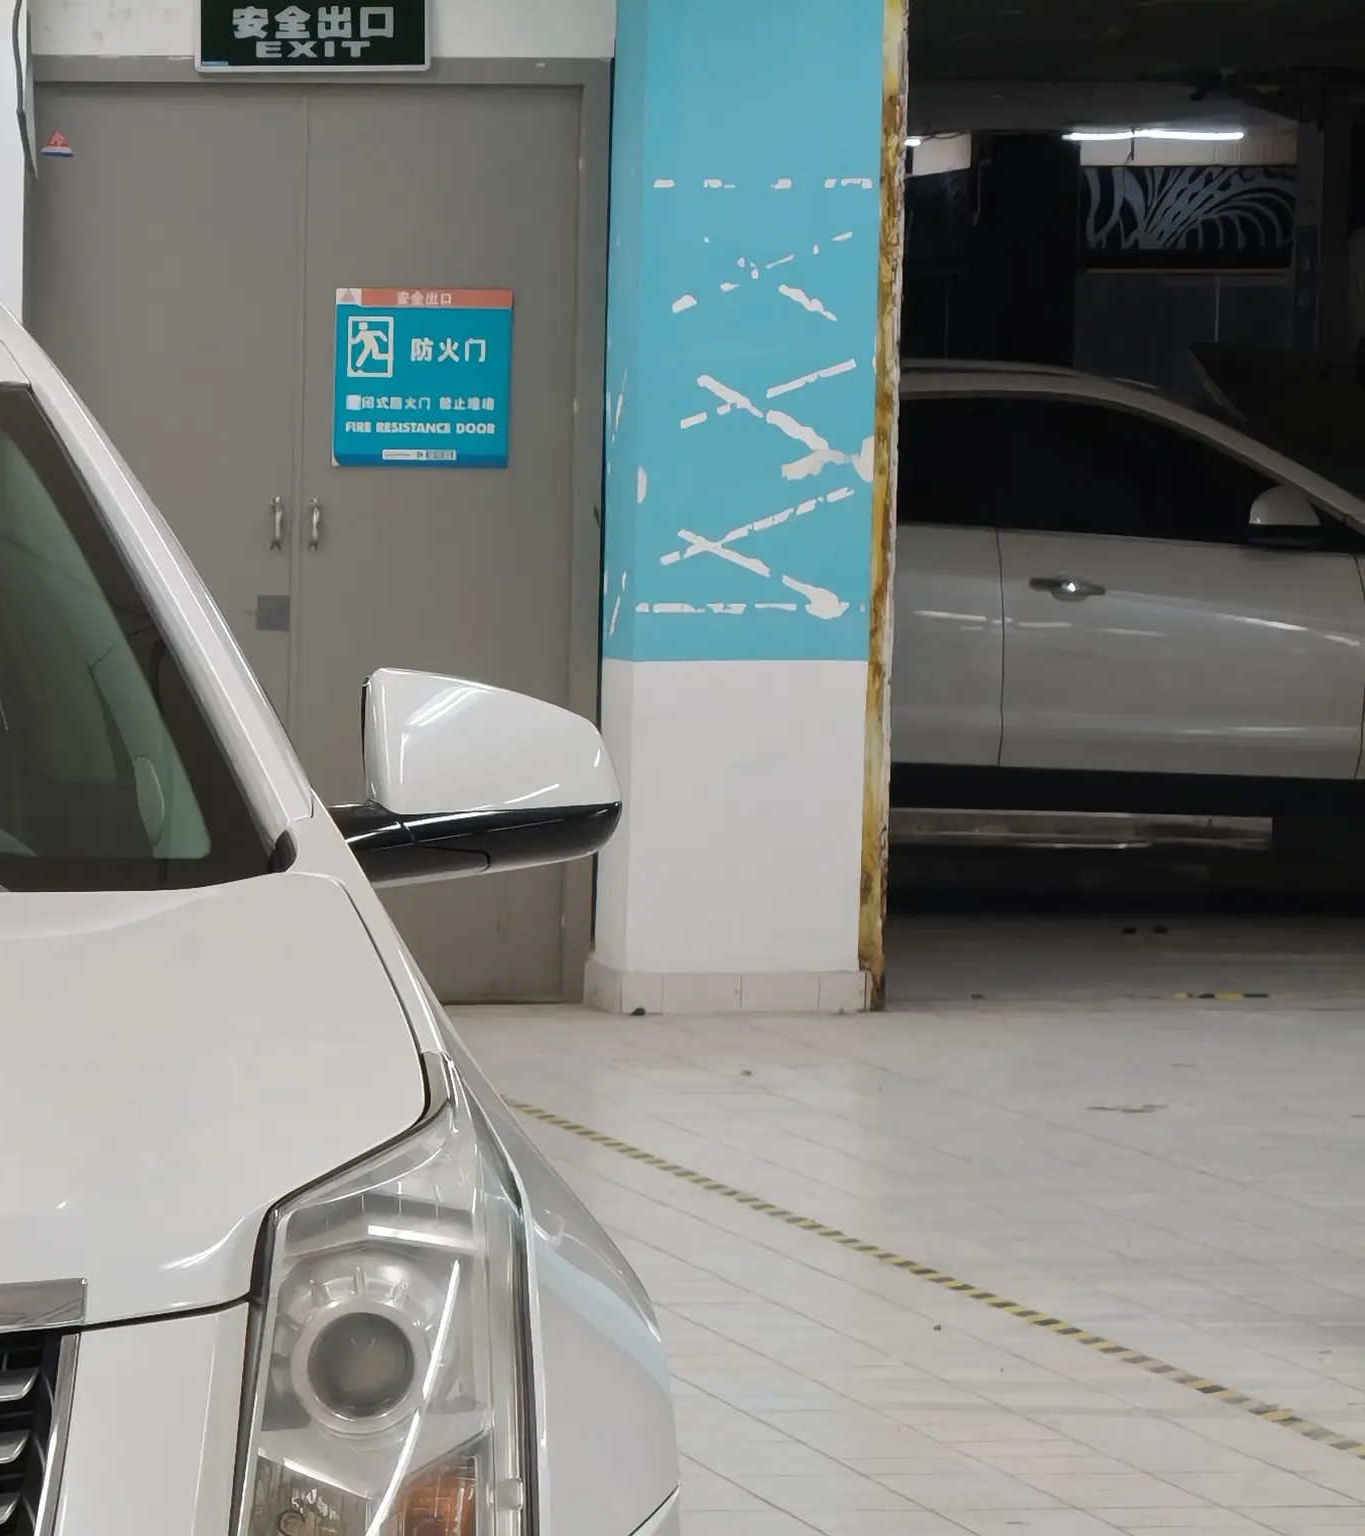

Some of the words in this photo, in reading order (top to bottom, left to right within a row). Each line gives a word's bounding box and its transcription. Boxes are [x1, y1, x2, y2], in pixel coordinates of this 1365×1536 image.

[232, 6, 394, 39] 安全出口
[255, 41, 371, 58] EXIT
[397, 290, 452, 306] 安全出口
[410, 337, 486, 362] 防火门
[345, 421, 371, 433] FIRE
[376, 422, 451, 434] RESISTANCE
[456, 422, 495, 435] DOOR
